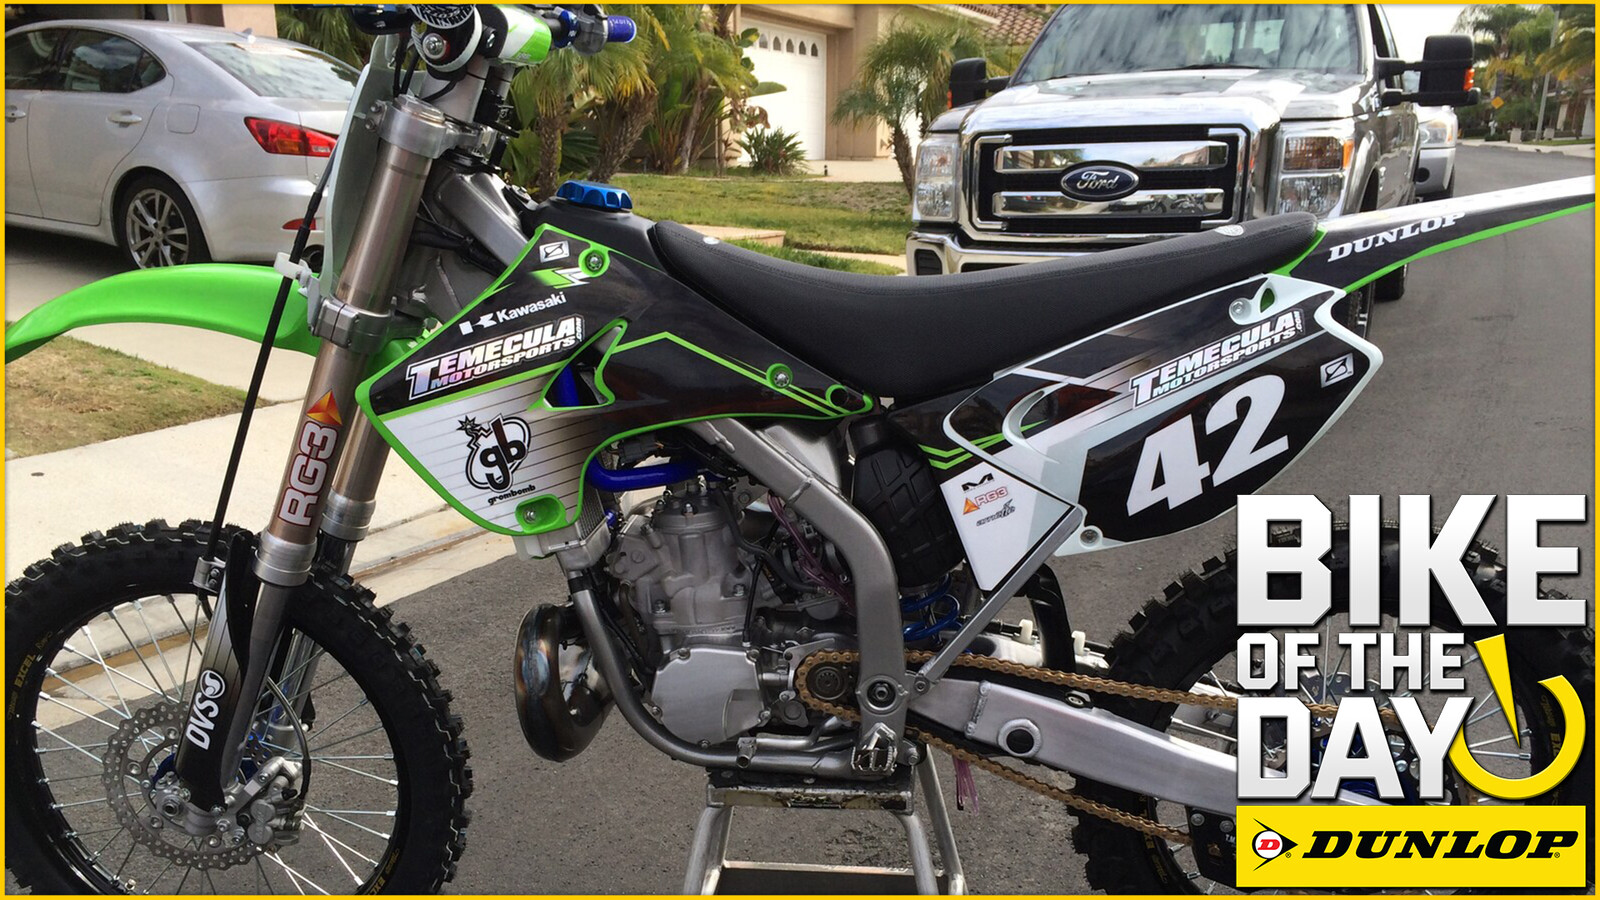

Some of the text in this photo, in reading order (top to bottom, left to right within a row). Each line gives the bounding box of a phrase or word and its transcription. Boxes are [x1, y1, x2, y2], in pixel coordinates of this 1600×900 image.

[1076, 170, 1120, 190] Ford
[1327, 212, 1466, 262] DUNLOP
[496, 291, 567, 324] Kawasaki
[410, 316, 576, 396] TEMECULA
[429, 335, 577, 391] MOTORSPORTS
[1131, 310, 1295, 406] TEMECULA
[1151, 326, 1297, 398] MOTORSPORTS
[278, 420, 338, 526] RG3
[1126, 374, 1290, 517] 42
[487, 484, 537, 506] grombomb
[14, 654, 37, 688] EXCEL
[185, 691, 220, 751] DVS
